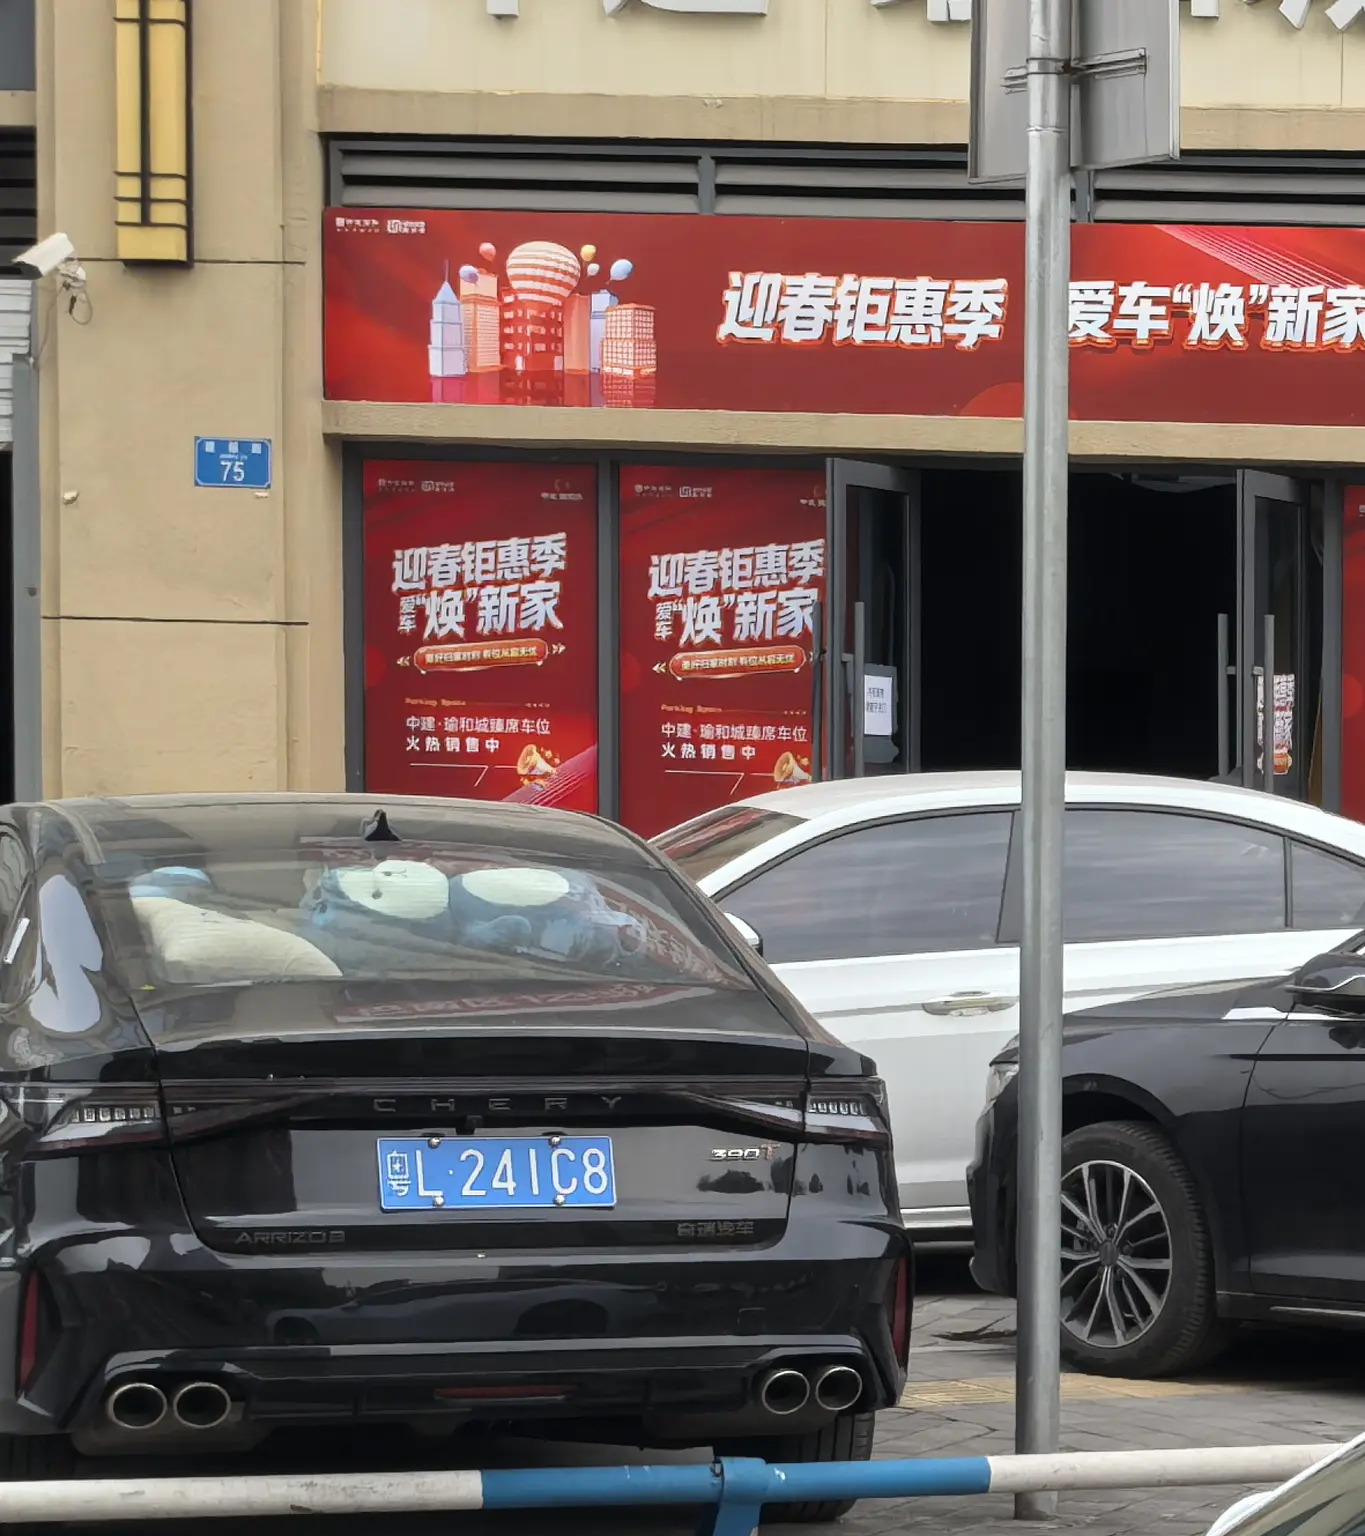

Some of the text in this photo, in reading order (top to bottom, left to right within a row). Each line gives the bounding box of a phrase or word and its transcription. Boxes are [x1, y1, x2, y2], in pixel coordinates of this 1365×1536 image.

[720, 271, 1006, 346] 迎春钜惠季
[220, 460, 245, 482] 75
[391, 532, 567, 594] 迎春钜惠季
[648, 538, 825, 600] 迎春钜惠季
[405, 735, 500, 753] 火热销售中
[661, 743, 756, 760] 火热销售中
[373, 1095, 622, 1114] CHERY
